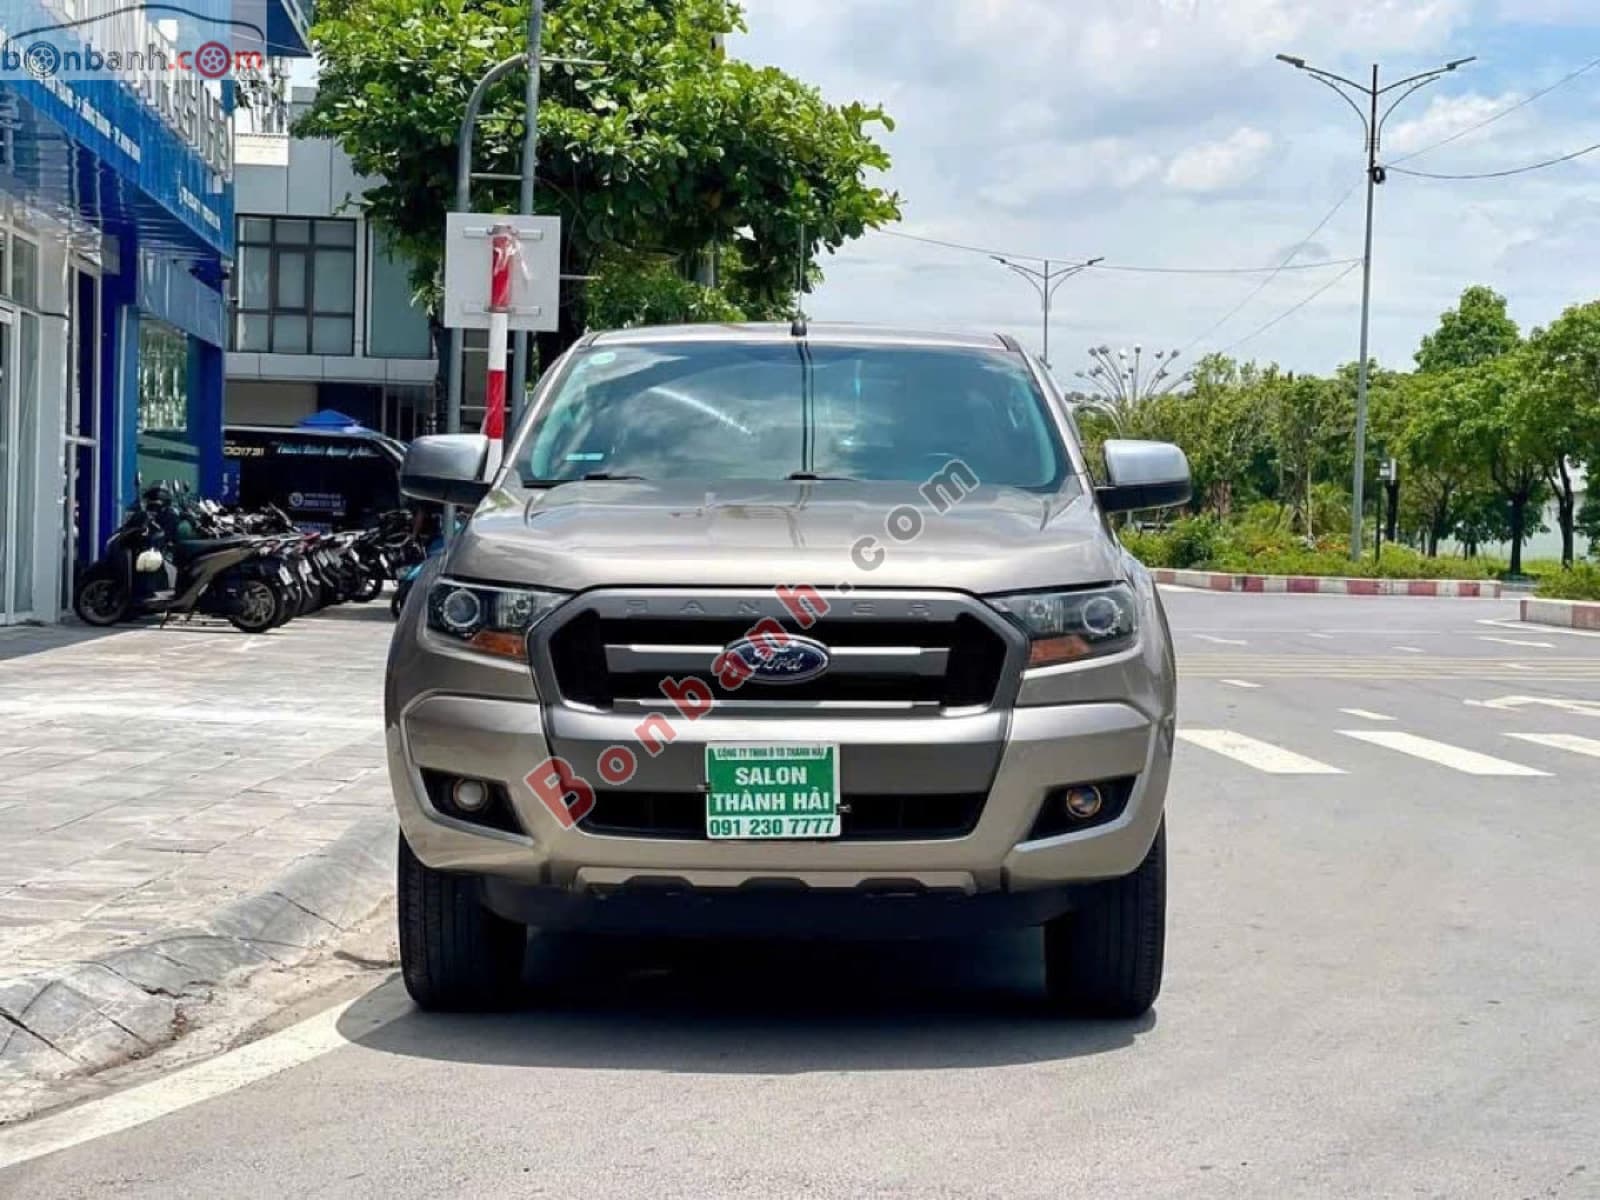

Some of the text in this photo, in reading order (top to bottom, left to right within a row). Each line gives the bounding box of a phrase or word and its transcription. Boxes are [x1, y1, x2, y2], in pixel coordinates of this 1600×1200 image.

[625, 600, 930, 617] RANER
[735, 766, 807, 785] SALON
[712, 786, 829, 811] THÀNH HẢI
[710, 818, 834, 835] 091 230 7777
